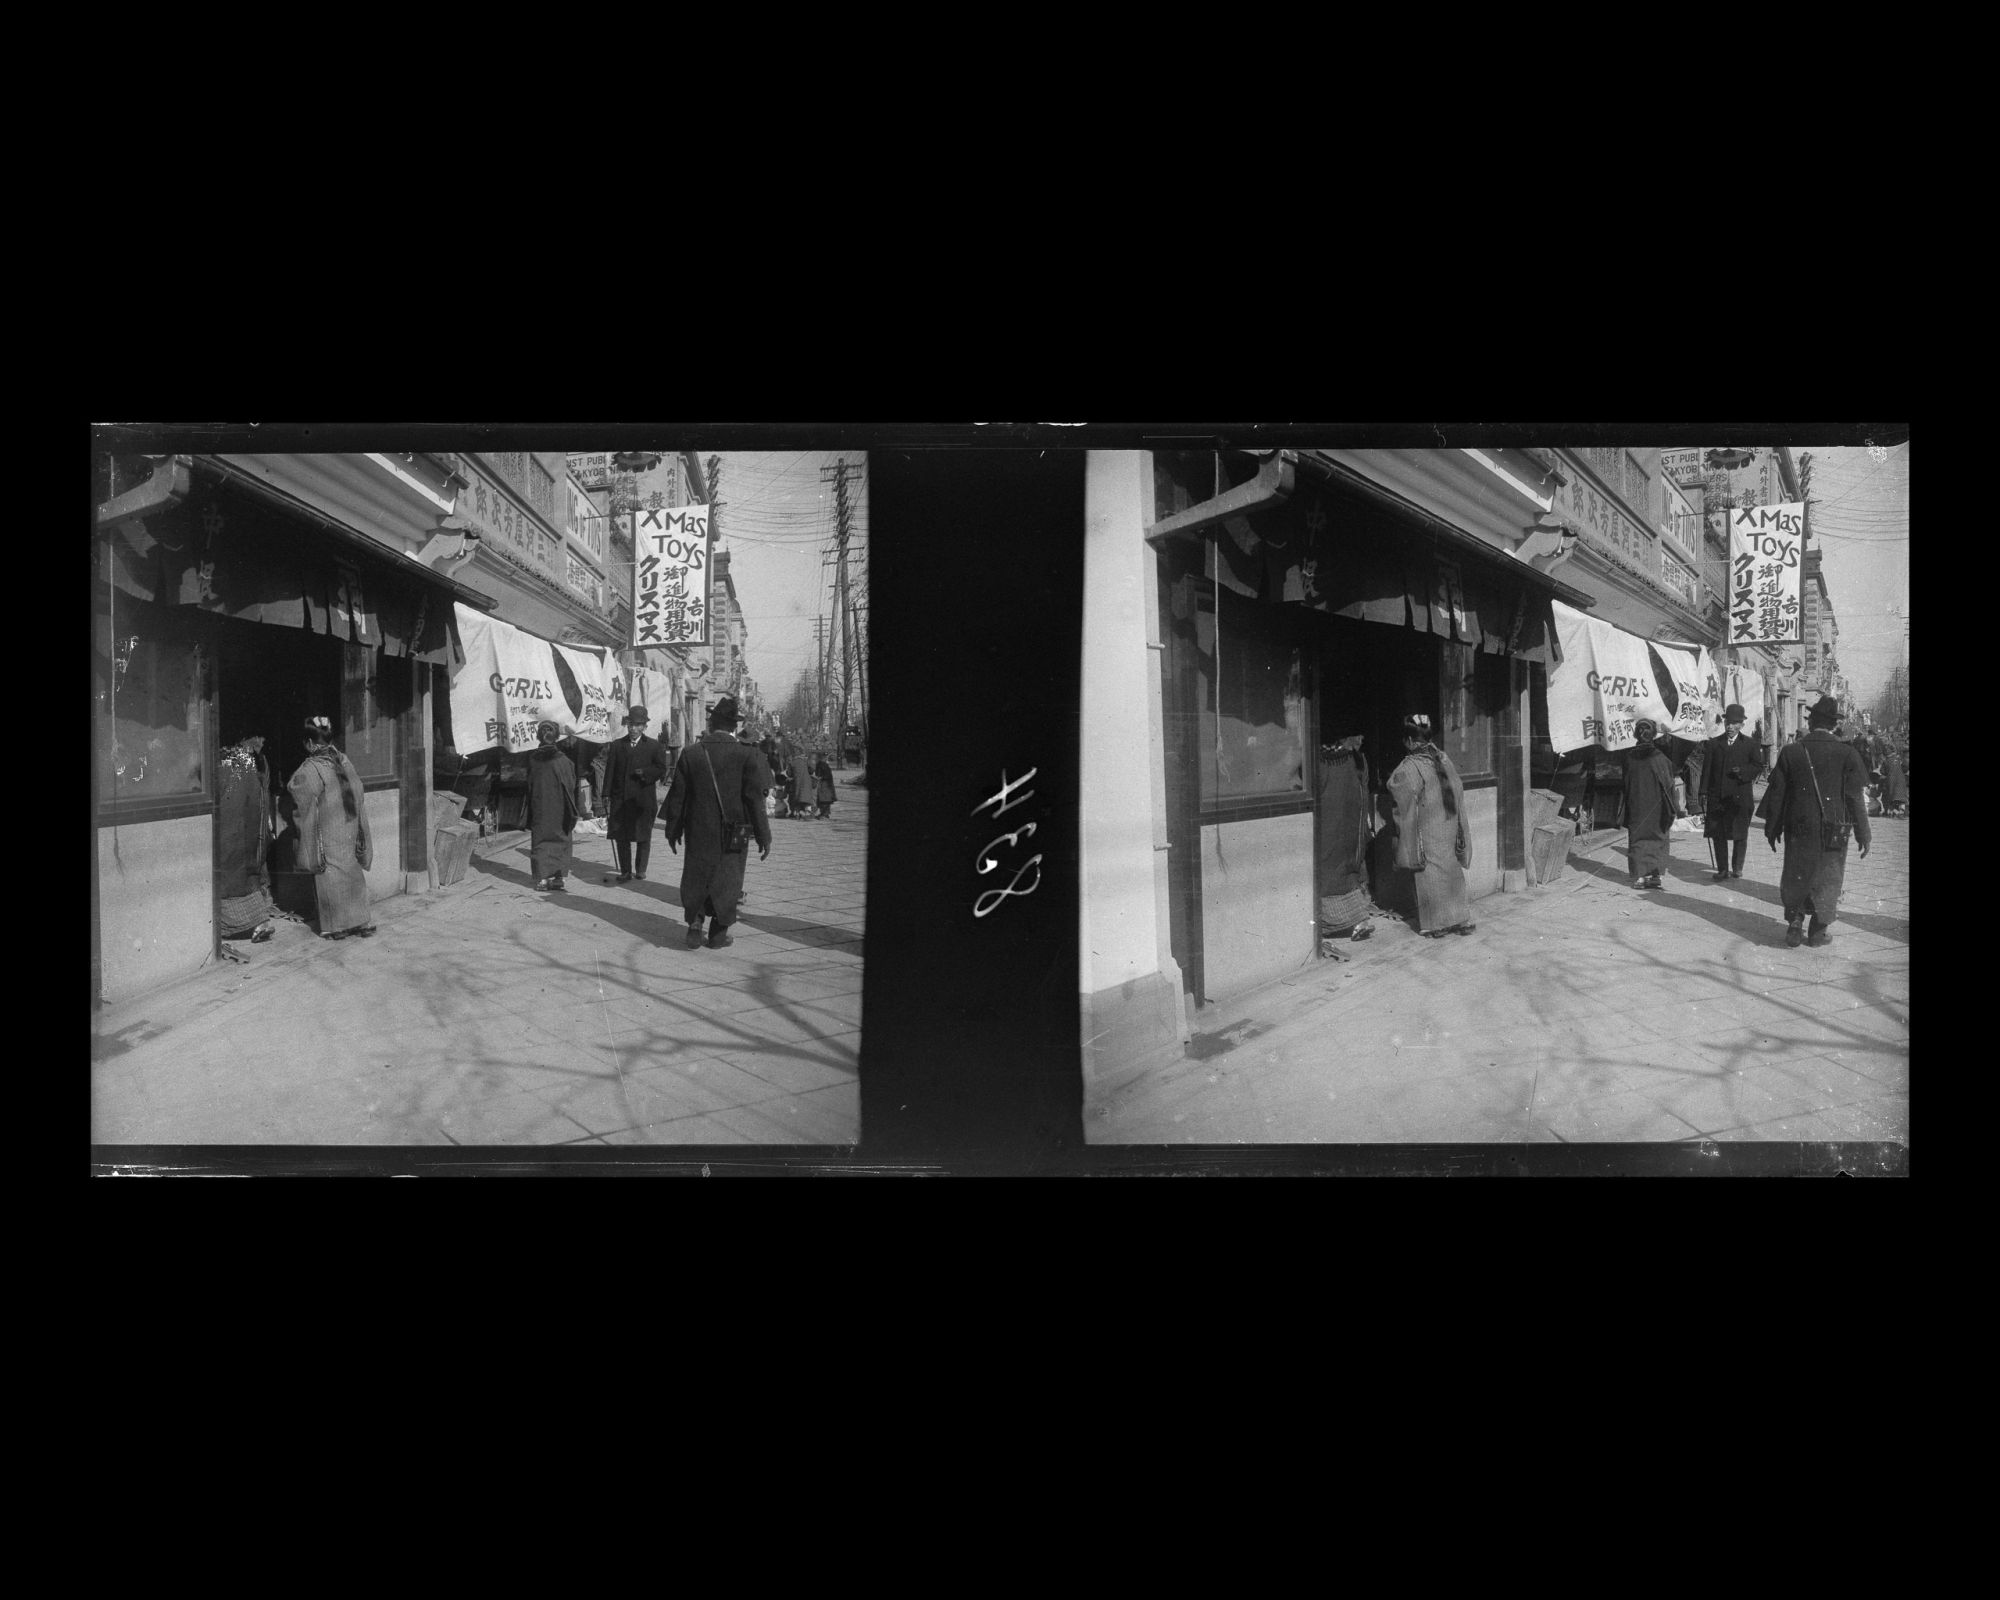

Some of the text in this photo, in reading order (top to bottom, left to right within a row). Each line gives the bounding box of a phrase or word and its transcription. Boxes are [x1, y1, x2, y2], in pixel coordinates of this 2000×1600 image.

[637, 555, 662, 642] クリスマス
[687, 596, 704, 641] 吉川
[1731, 552, 1757, 640] クリスマス
[1782, 594, 1799, 639] 吉川
